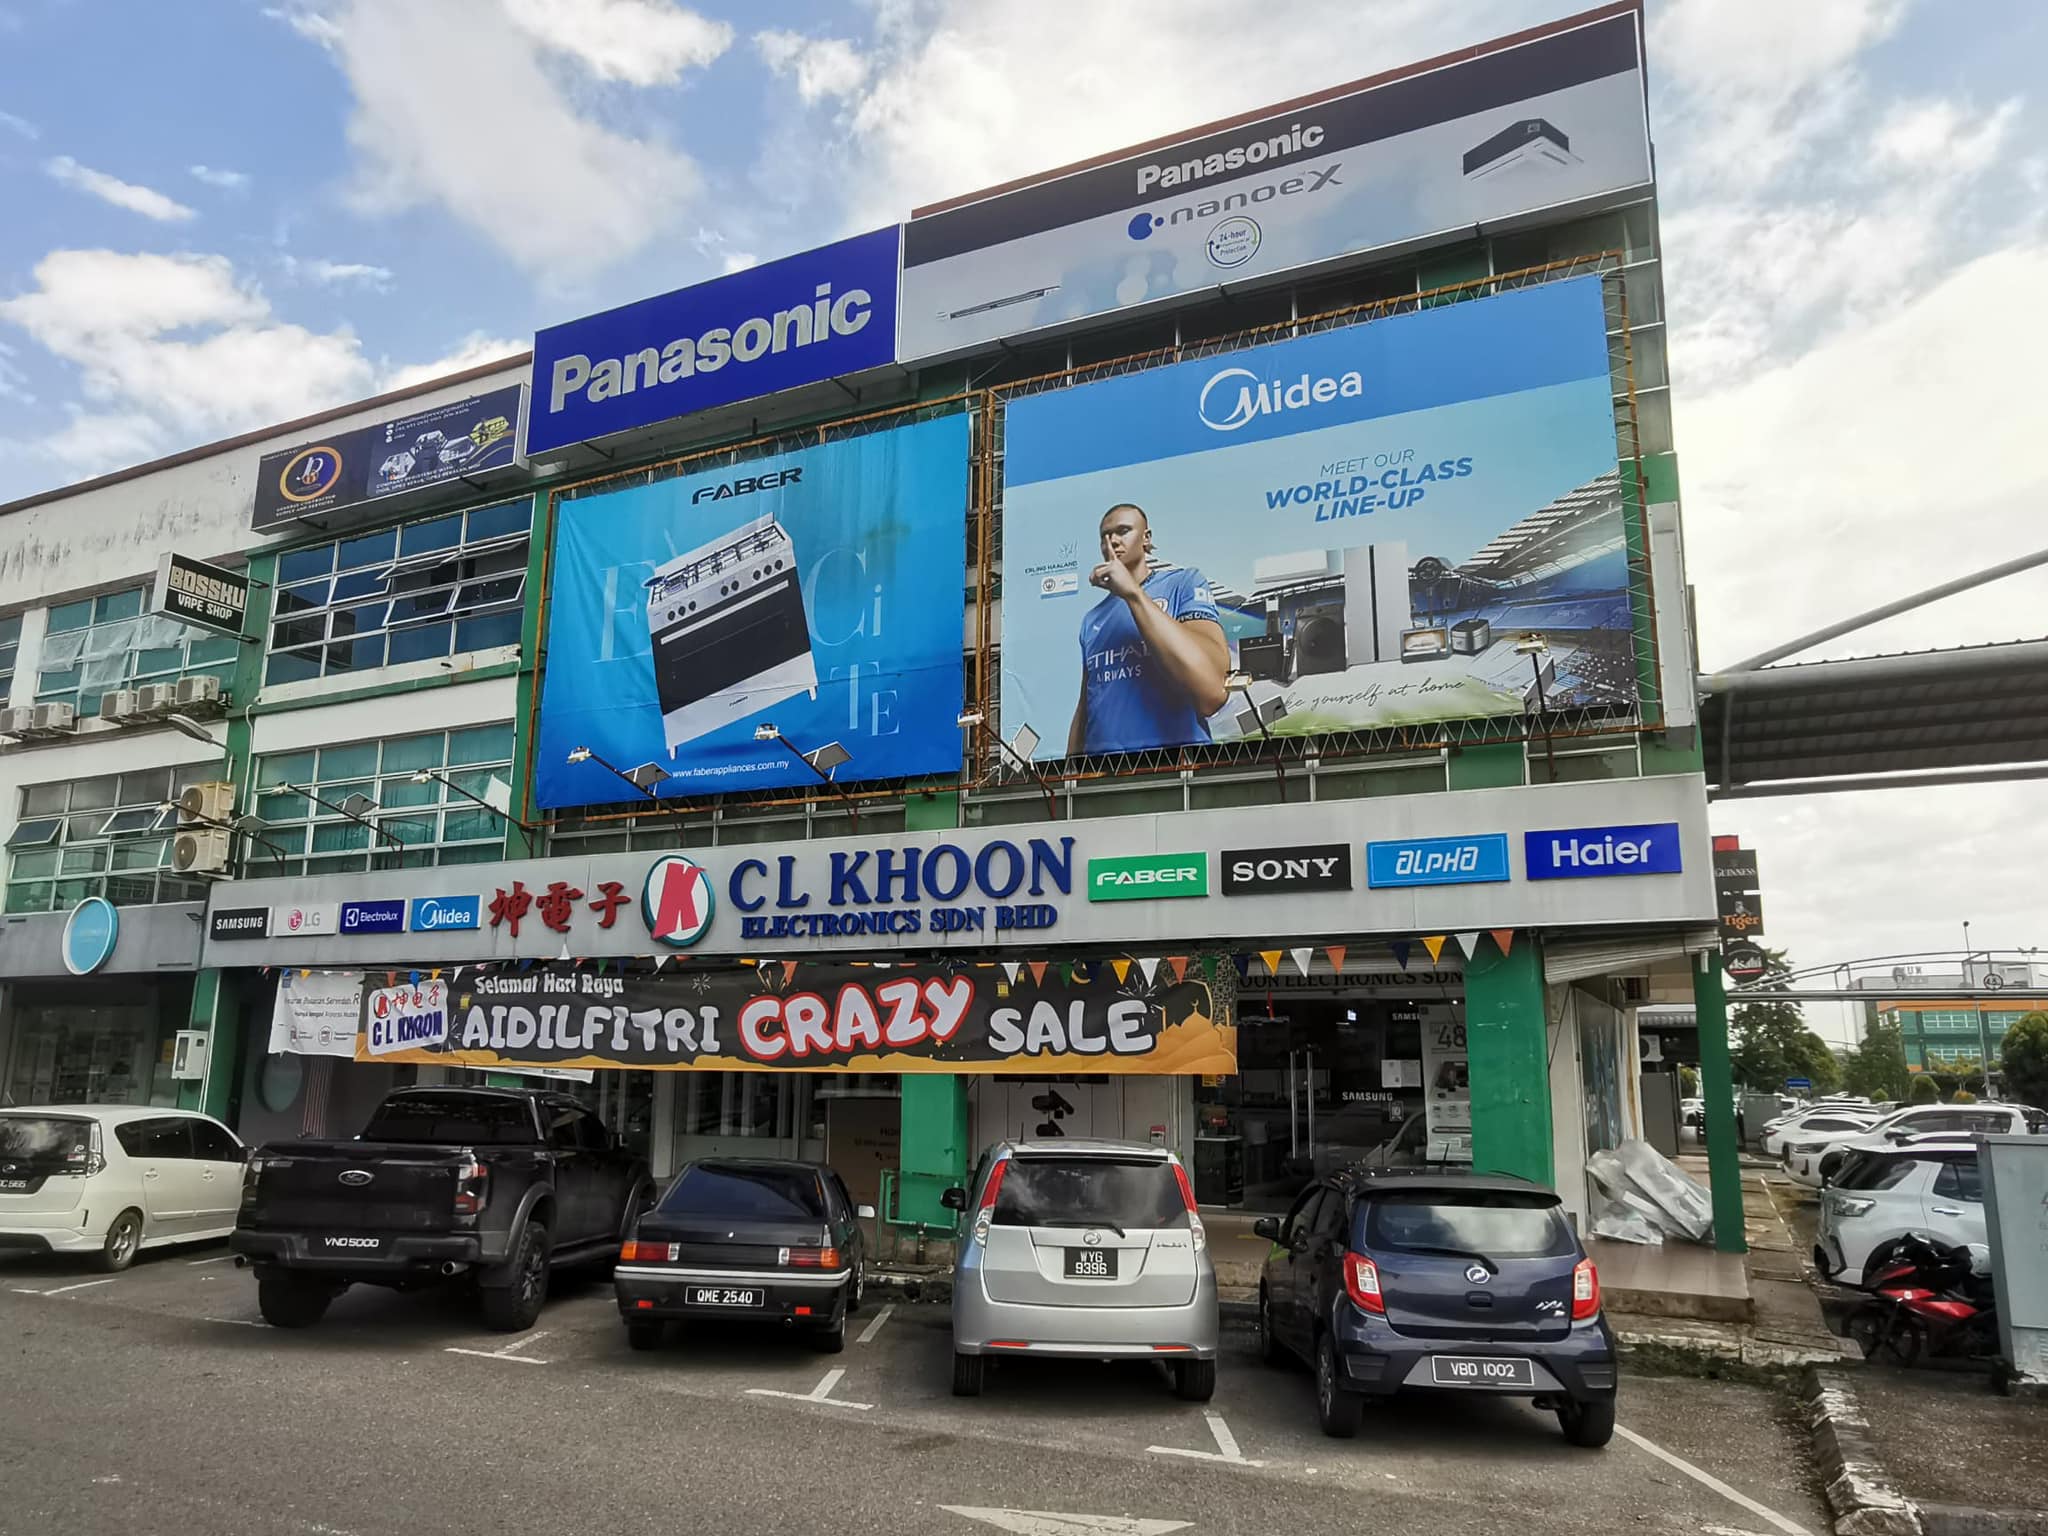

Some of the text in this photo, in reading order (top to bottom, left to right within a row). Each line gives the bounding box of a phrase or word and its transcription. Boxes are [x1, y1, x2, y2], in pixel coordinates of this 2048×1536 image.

[1137, 123, 1325, 195] Panasonic
[549, 282, 872, 413] Panasonic
[1210, 369, 1362, 426] Midea
[1320, 449, 1415, 477] MEET OUR
[691, 467, 803, 505] FABER
[1266, 457, 1472, 509] WORLD-CLASS
[1315, 487, 1425, 522] LINE-UP
[178, 593, 233, 620] VAPE SHOP
[1311, 683, 1383, 711] yourself
[1388, 683, 1416, 696] at
[1418, 677, 1466, 695] home
[672, 760, 789, 778] www.faberappliances.com.my
[1551, 835, 1651, 868] Haier
[829, 836, 1075, 904] KHOON
[1096, 866, 1198, 886] FABER
[1232, 856, 1339, 883] SONY
[360, 911, 399, 923] Electrolux
[424, 902, 471, 927] Midea
[488, 880, 631, 938] 坤電子
[740, 904, 1059, 940] ELECTRONICS SDN BHD
[1722, 913, 1760, 930] Tiger
[215, 917, 264, 930] SAMSUNG
[475, 973, 624, 998] Selamat Hari Raya
[462, 975, 1156, 1060] AIDILFITRI CRAZY SALE
[1342, 1092, 1394, 1102] SAMSUNG
[348, 1238, 380, 1248] 5000
[1075, 1262, 1108, 1275] 9396
[723, 1290, 753, 1304] 2540
[1450, 1362, 1516, 1378] VBD 1002
